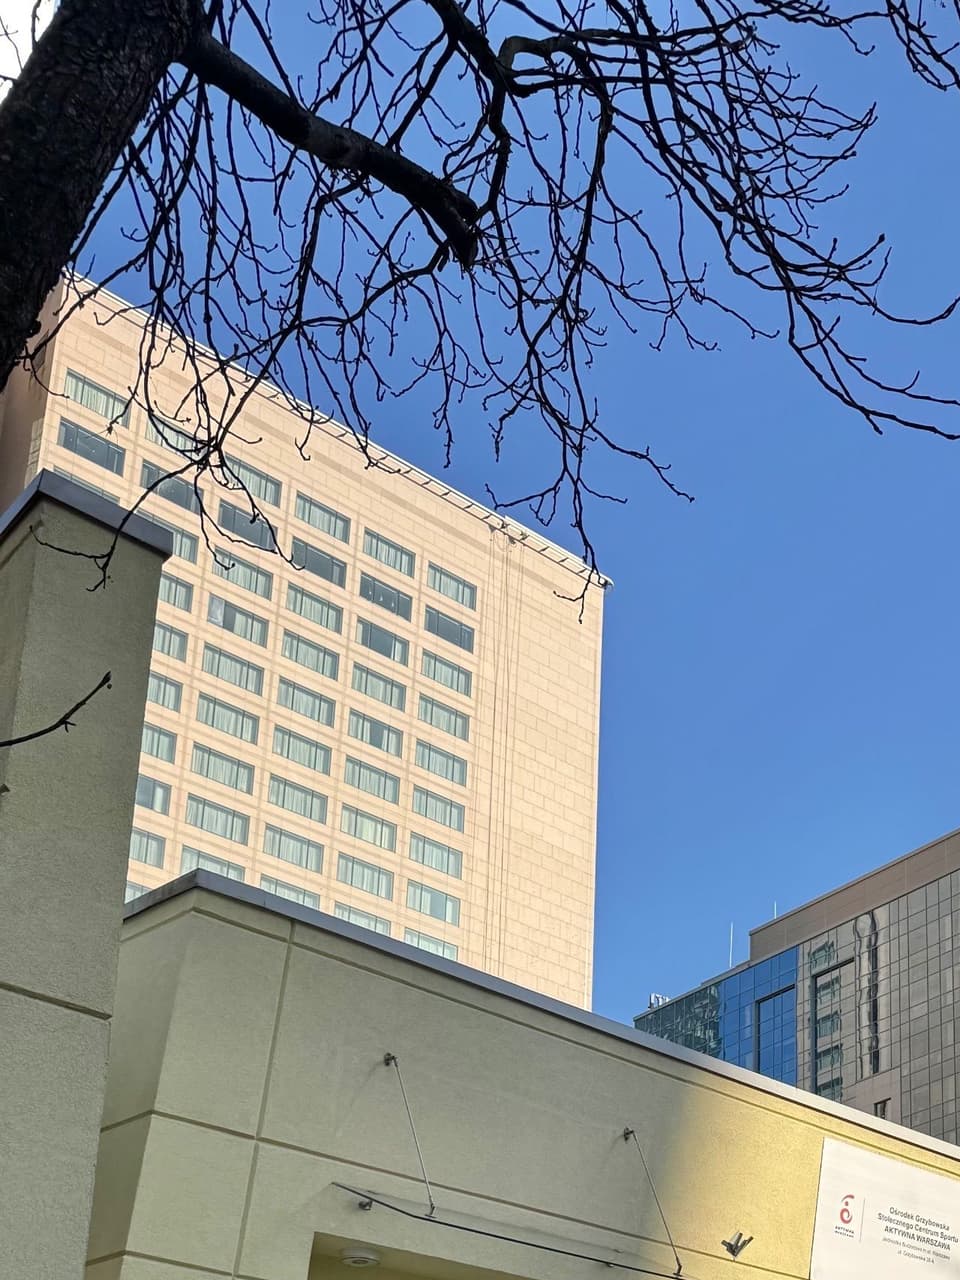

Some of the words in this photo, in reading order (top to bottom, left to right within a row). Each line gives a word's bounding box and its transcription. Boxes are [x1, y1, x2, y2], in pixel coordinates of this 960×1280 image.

[889, 1206, 914, 1221] Ośrodek
[915, 1214, 950, 1231] Grzybowska
[884, 1225, 916, 1241] AKTYWNA
[916, 1234, 951, 1251] WARSZAWA
[914, 1224, 940, 1237] Centrum
[940, 1231, 959, 1243] Sportu
